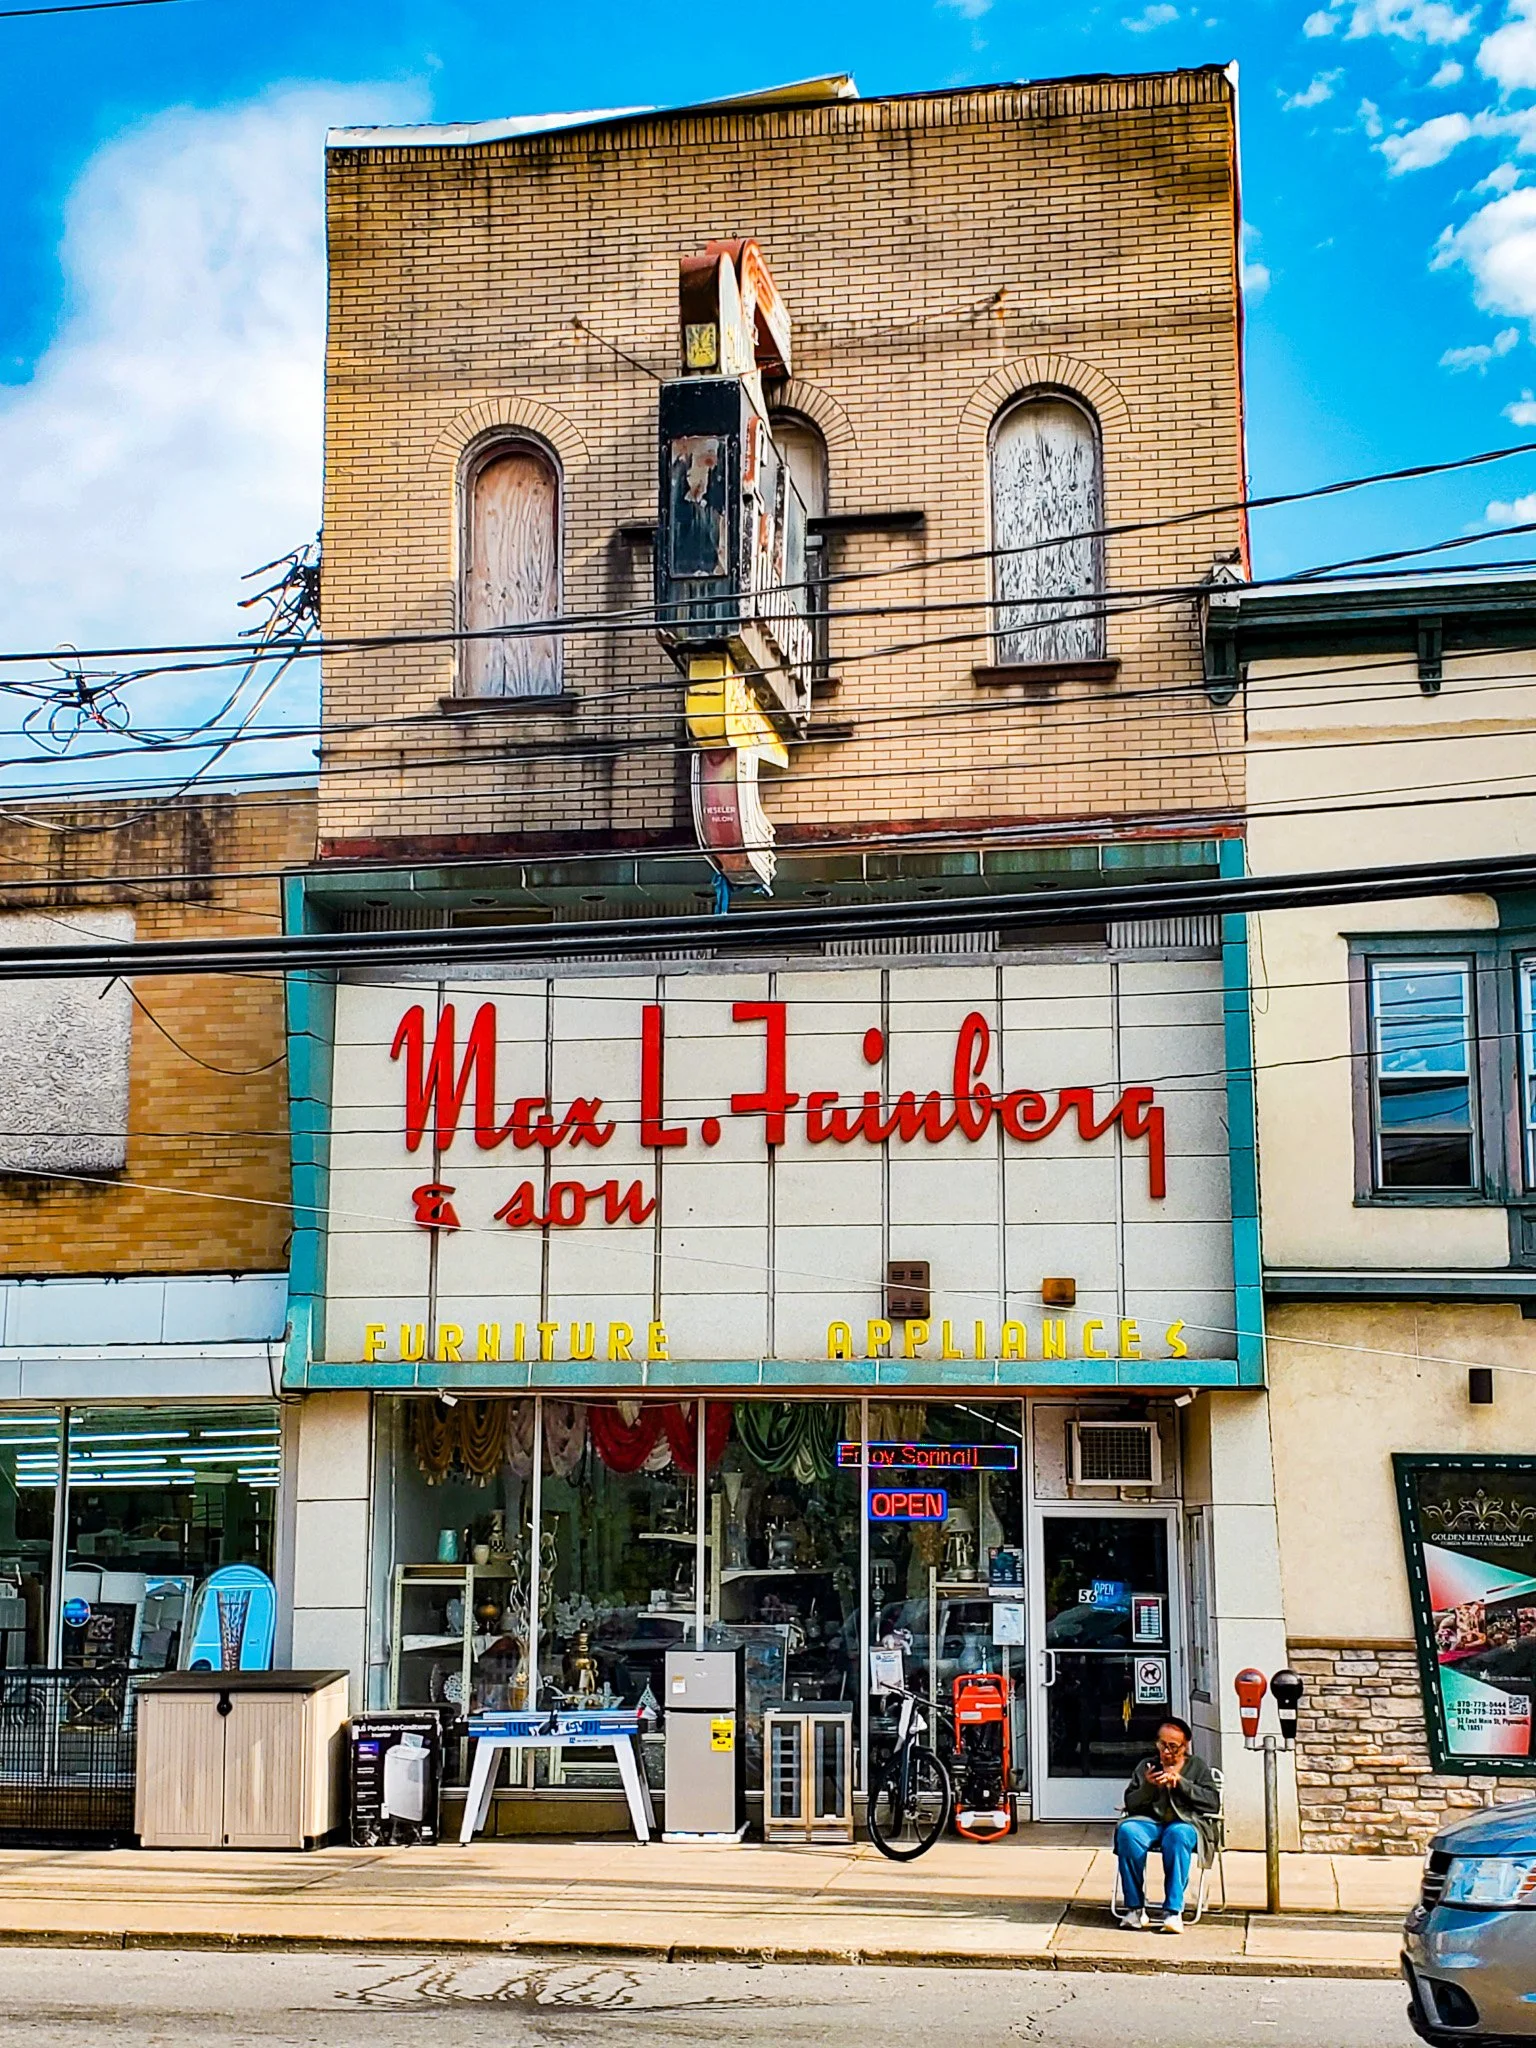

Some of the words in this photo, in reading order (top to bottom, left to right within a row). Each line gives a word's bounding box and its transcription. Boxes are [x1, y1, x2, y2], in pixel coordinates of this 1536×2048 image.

[389, 1001, 616, 1152] Max
[641, 1004, 721, 1147] L.
[731, 1002, 1166, 1198] Fainberg
[411, 1183, 461, 1234] &
[362, 1321, 670, 1361] FURNITURE
[827, 1319, 1188, 1359] APPLIANCES
[872, 1493, 943, 1517] OPEN
[1431, 1533, 1465, 1541] GOLDEN
[1467, 1534, 1518, 1542] RESTAURANT
[1519, 1534, 1533, 1542] LLC
[1080, 1590, 1097, 1602] 56
[1094, 1582, 1115, 1596] OPEN
